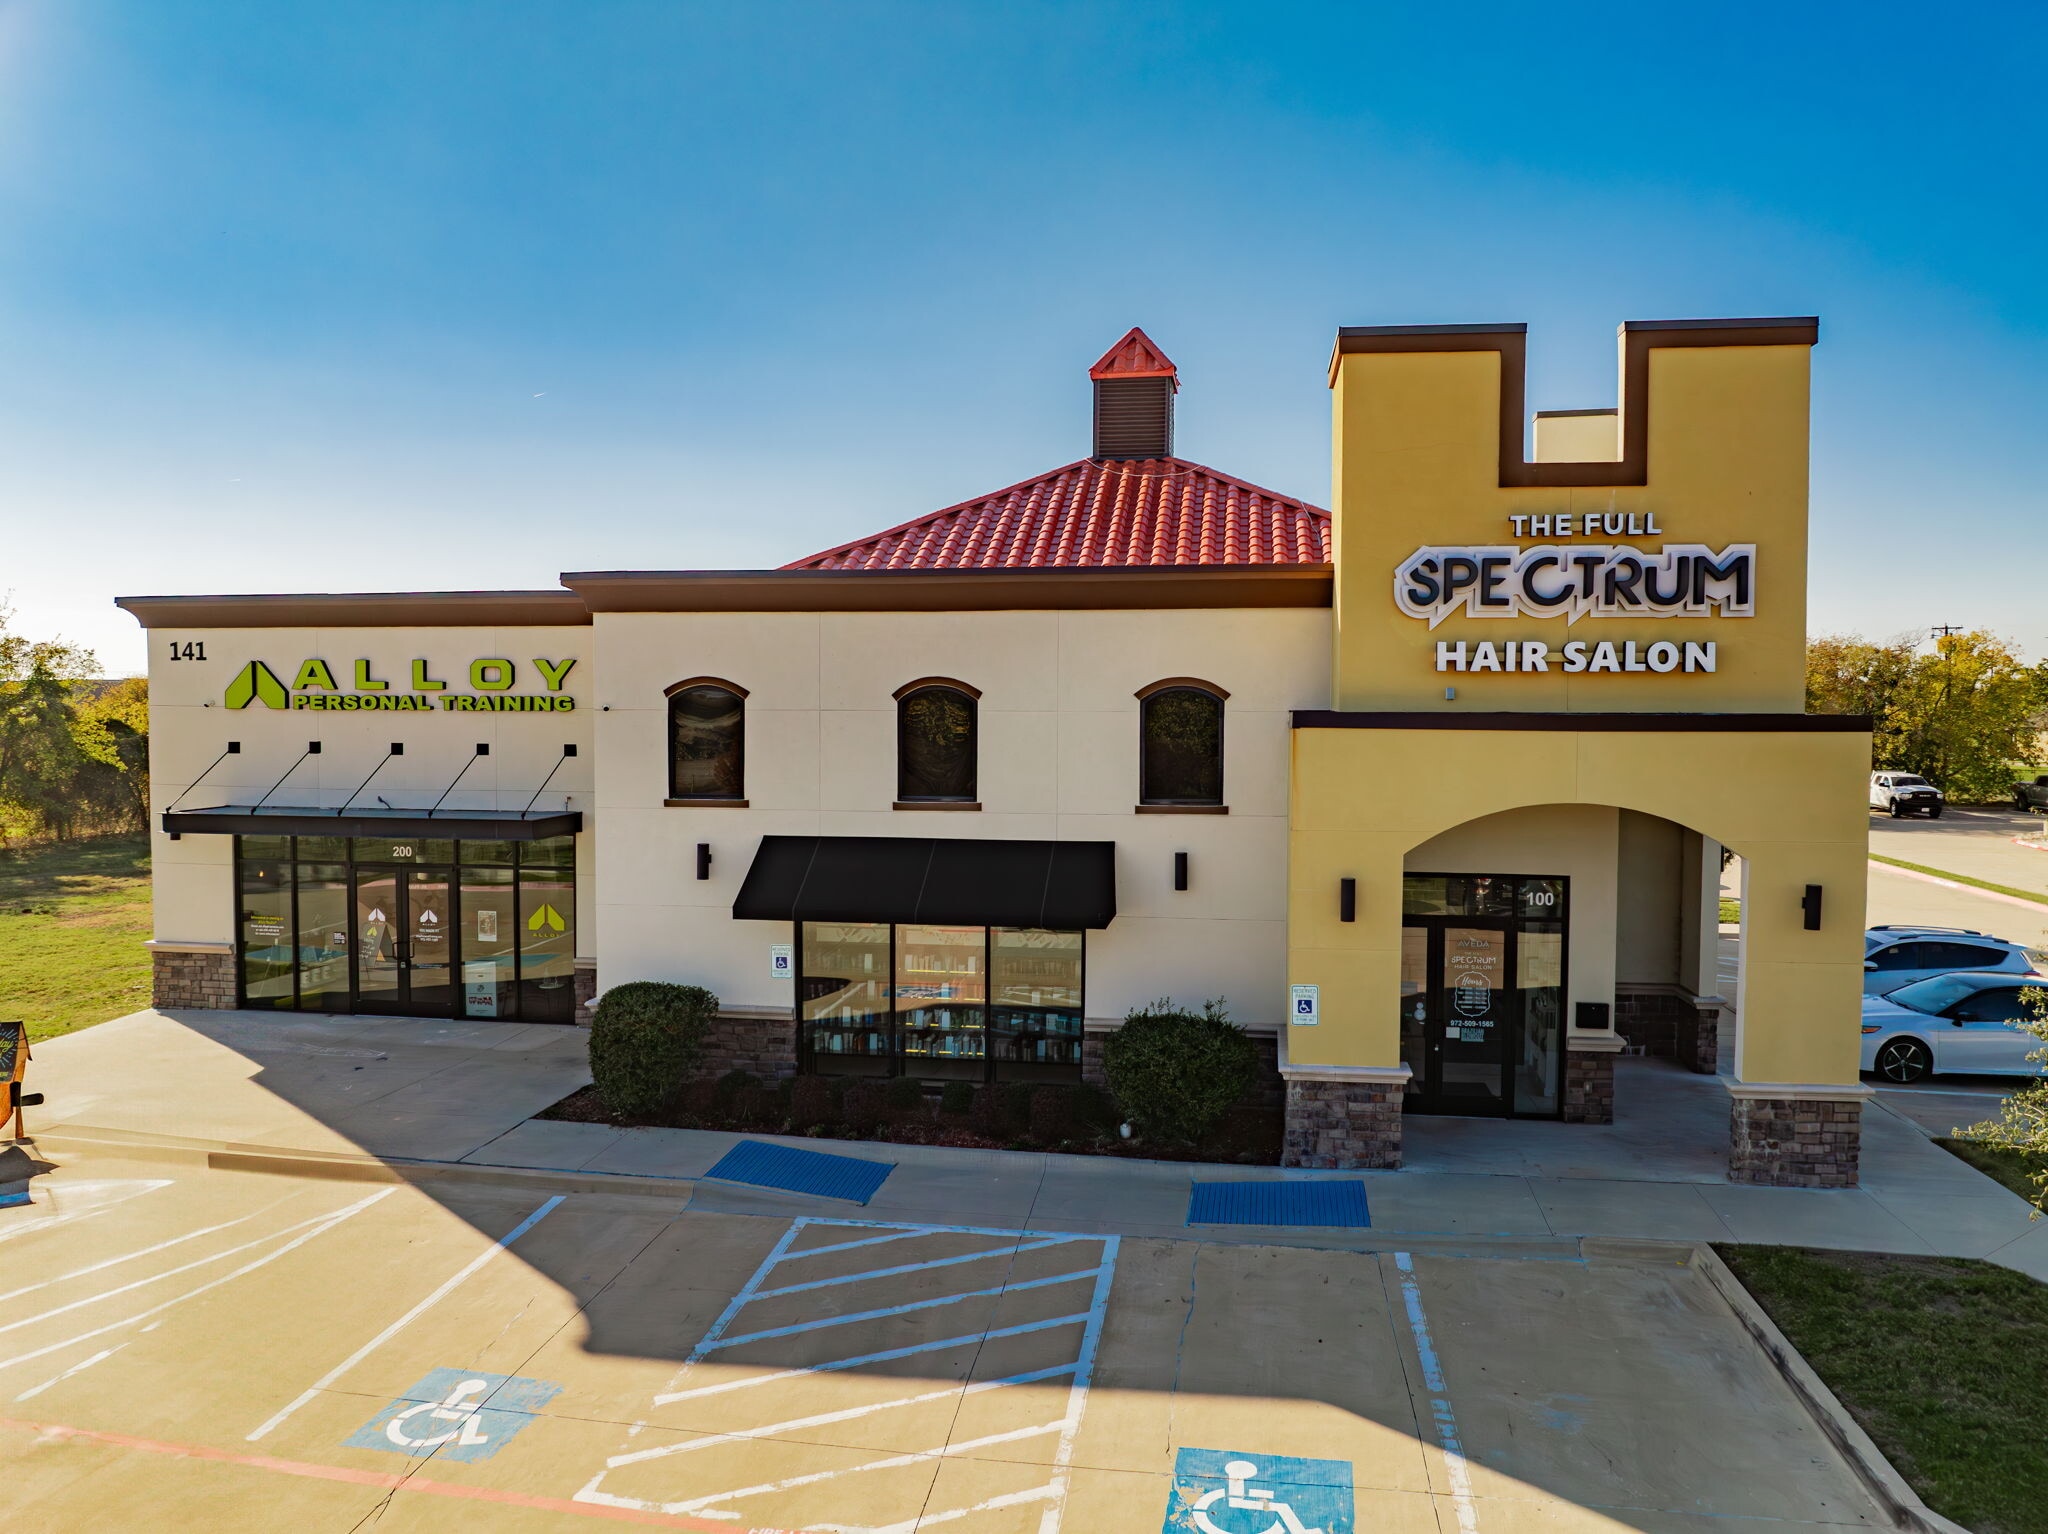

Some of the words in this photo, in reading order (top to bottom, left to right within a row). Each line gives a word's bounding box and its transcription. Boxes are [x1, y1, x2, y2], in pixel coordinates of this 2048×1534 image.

[1509, 514, 1573, 537] THE
[1582, 512, 1663, 536] FULL
[1407, 555, 1750, 606] SPECTRUM
[170, 641, 207, 661] 141
[1436, 641, 1549, 672] HAIR
[1563, 641, 1717, 673] SALON
[292, 659, 576, 691] ALLOY
[293, 695, 434, 711] PERSONAL
[439, 695, 575, 712] TRAINING
[392, 846, 413, 857] 200
[1526, 892, 1554, 906] 100
[1451, 956, 1496, 964] SPECTRUM
